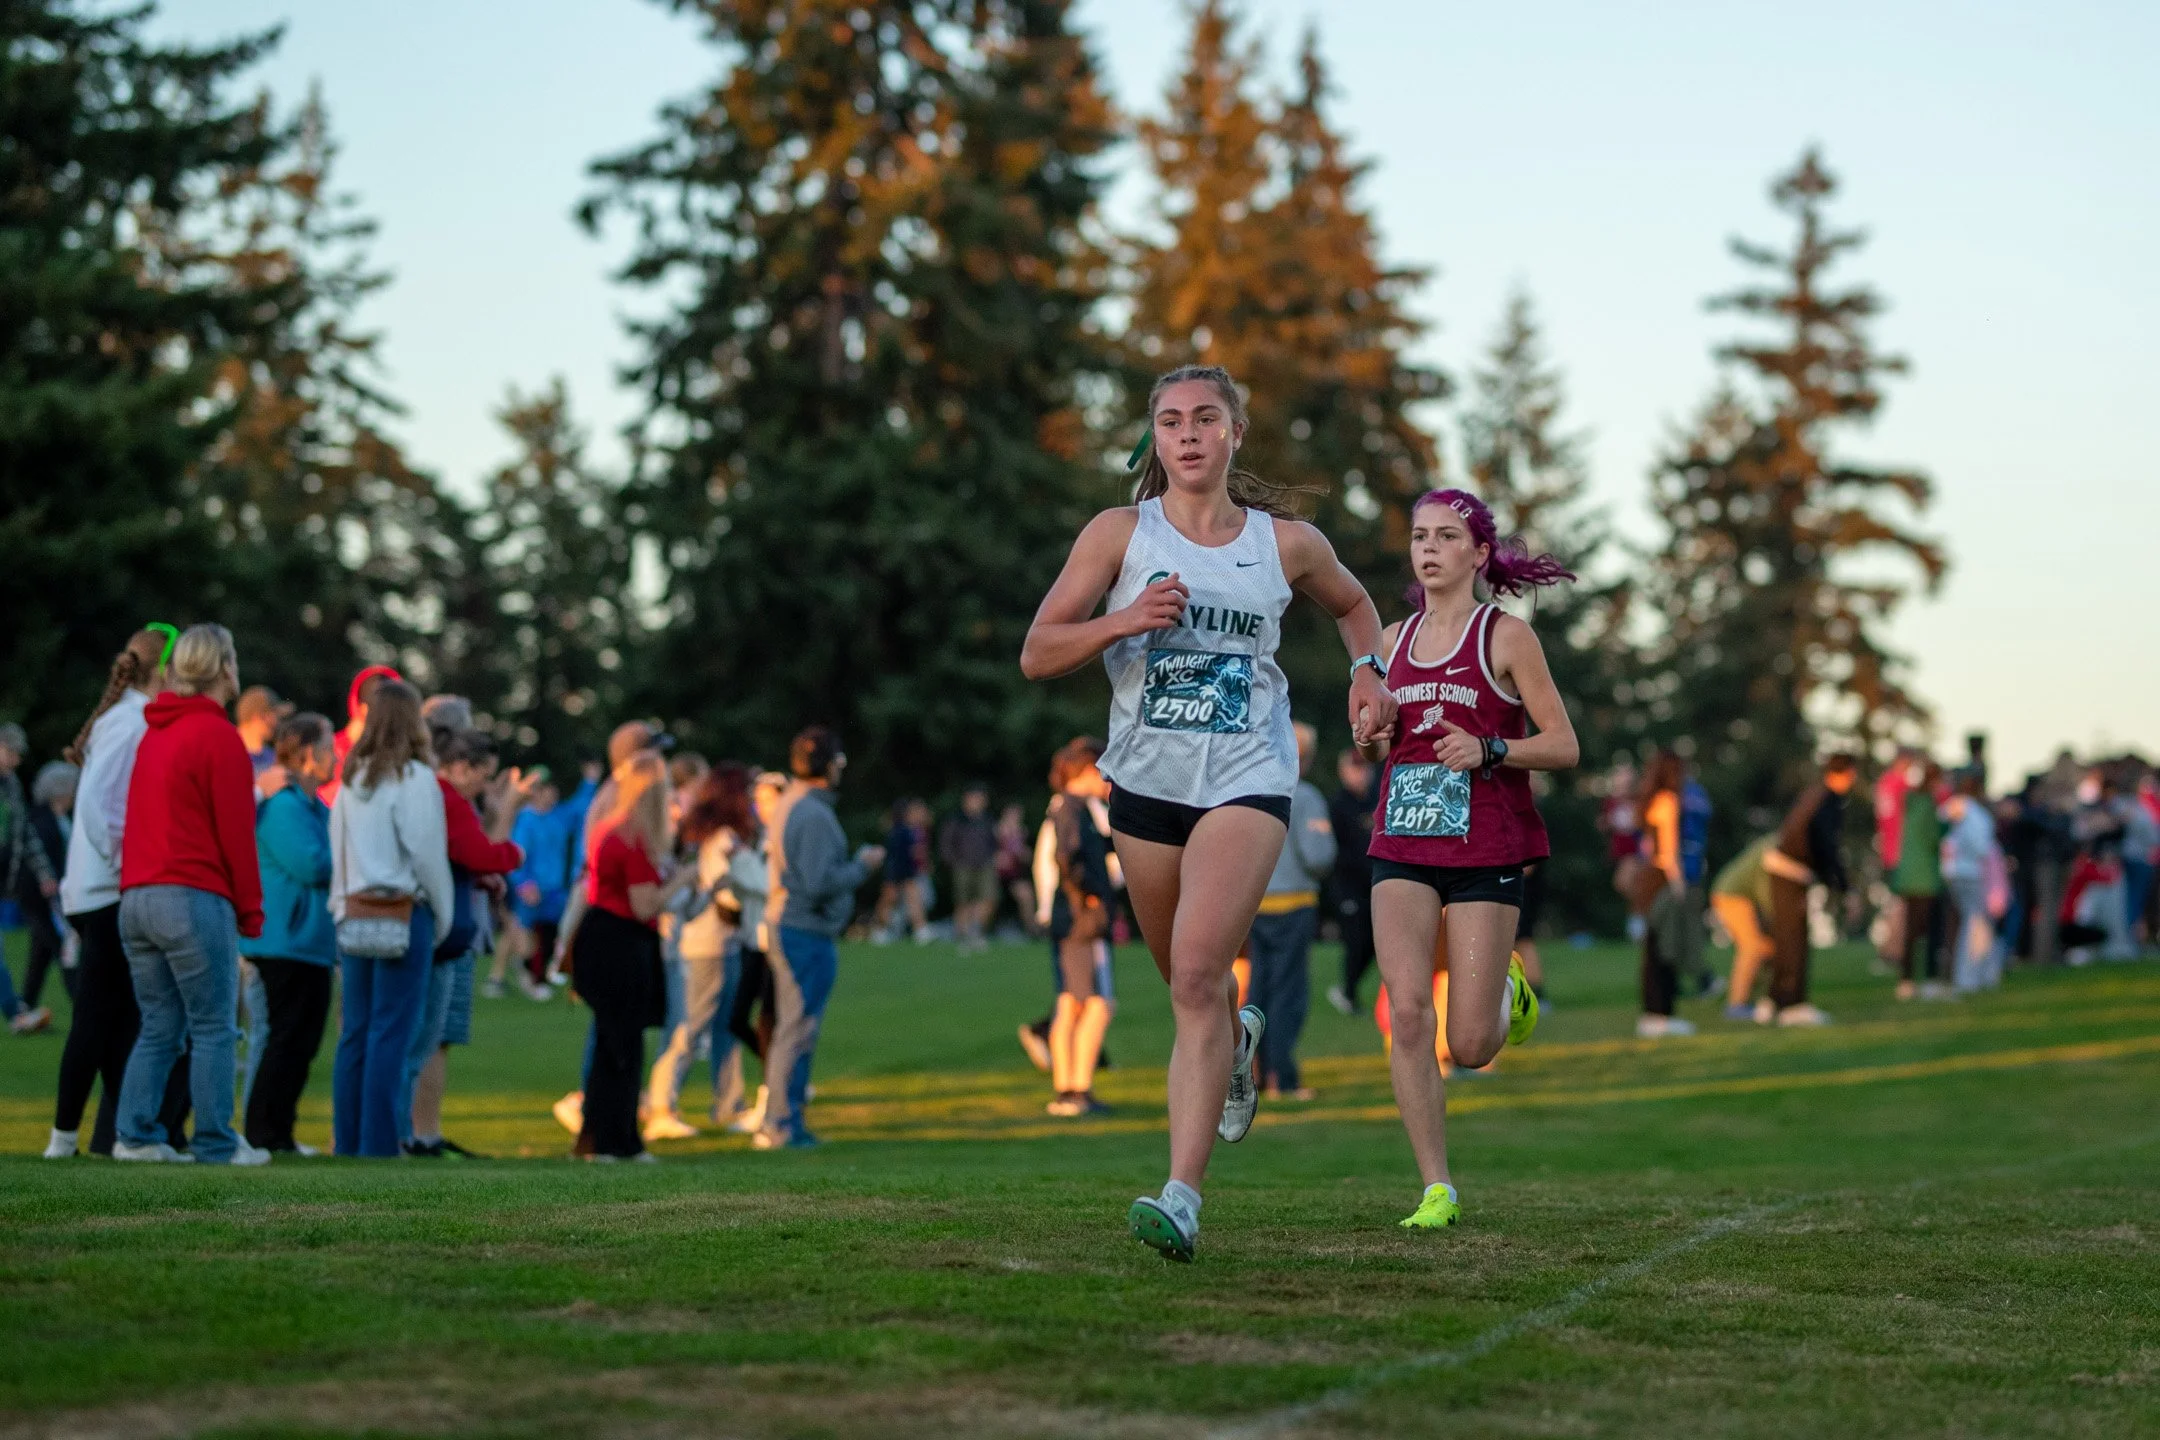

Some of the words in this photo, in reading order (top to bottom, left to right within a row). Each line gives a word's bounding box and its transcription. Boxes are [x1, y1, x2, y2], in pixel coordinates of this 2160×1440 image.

[1176, 604, 1265, 638] YLINE
[1154, 654, 1217, 678] TWILIGHT
[1164, 669, 1195, 686] XC
[1392, 682, 1438, 705] RTHWEST
[1439, 682, 1478, 709] SCHOOL
[1151, 696, 1213, 724] 2500
[1395, 765, 1439, 789] TWILIGHT
[1401, 780, 1422, 797] XC
[1391, 805, 1443, 830] 2815
